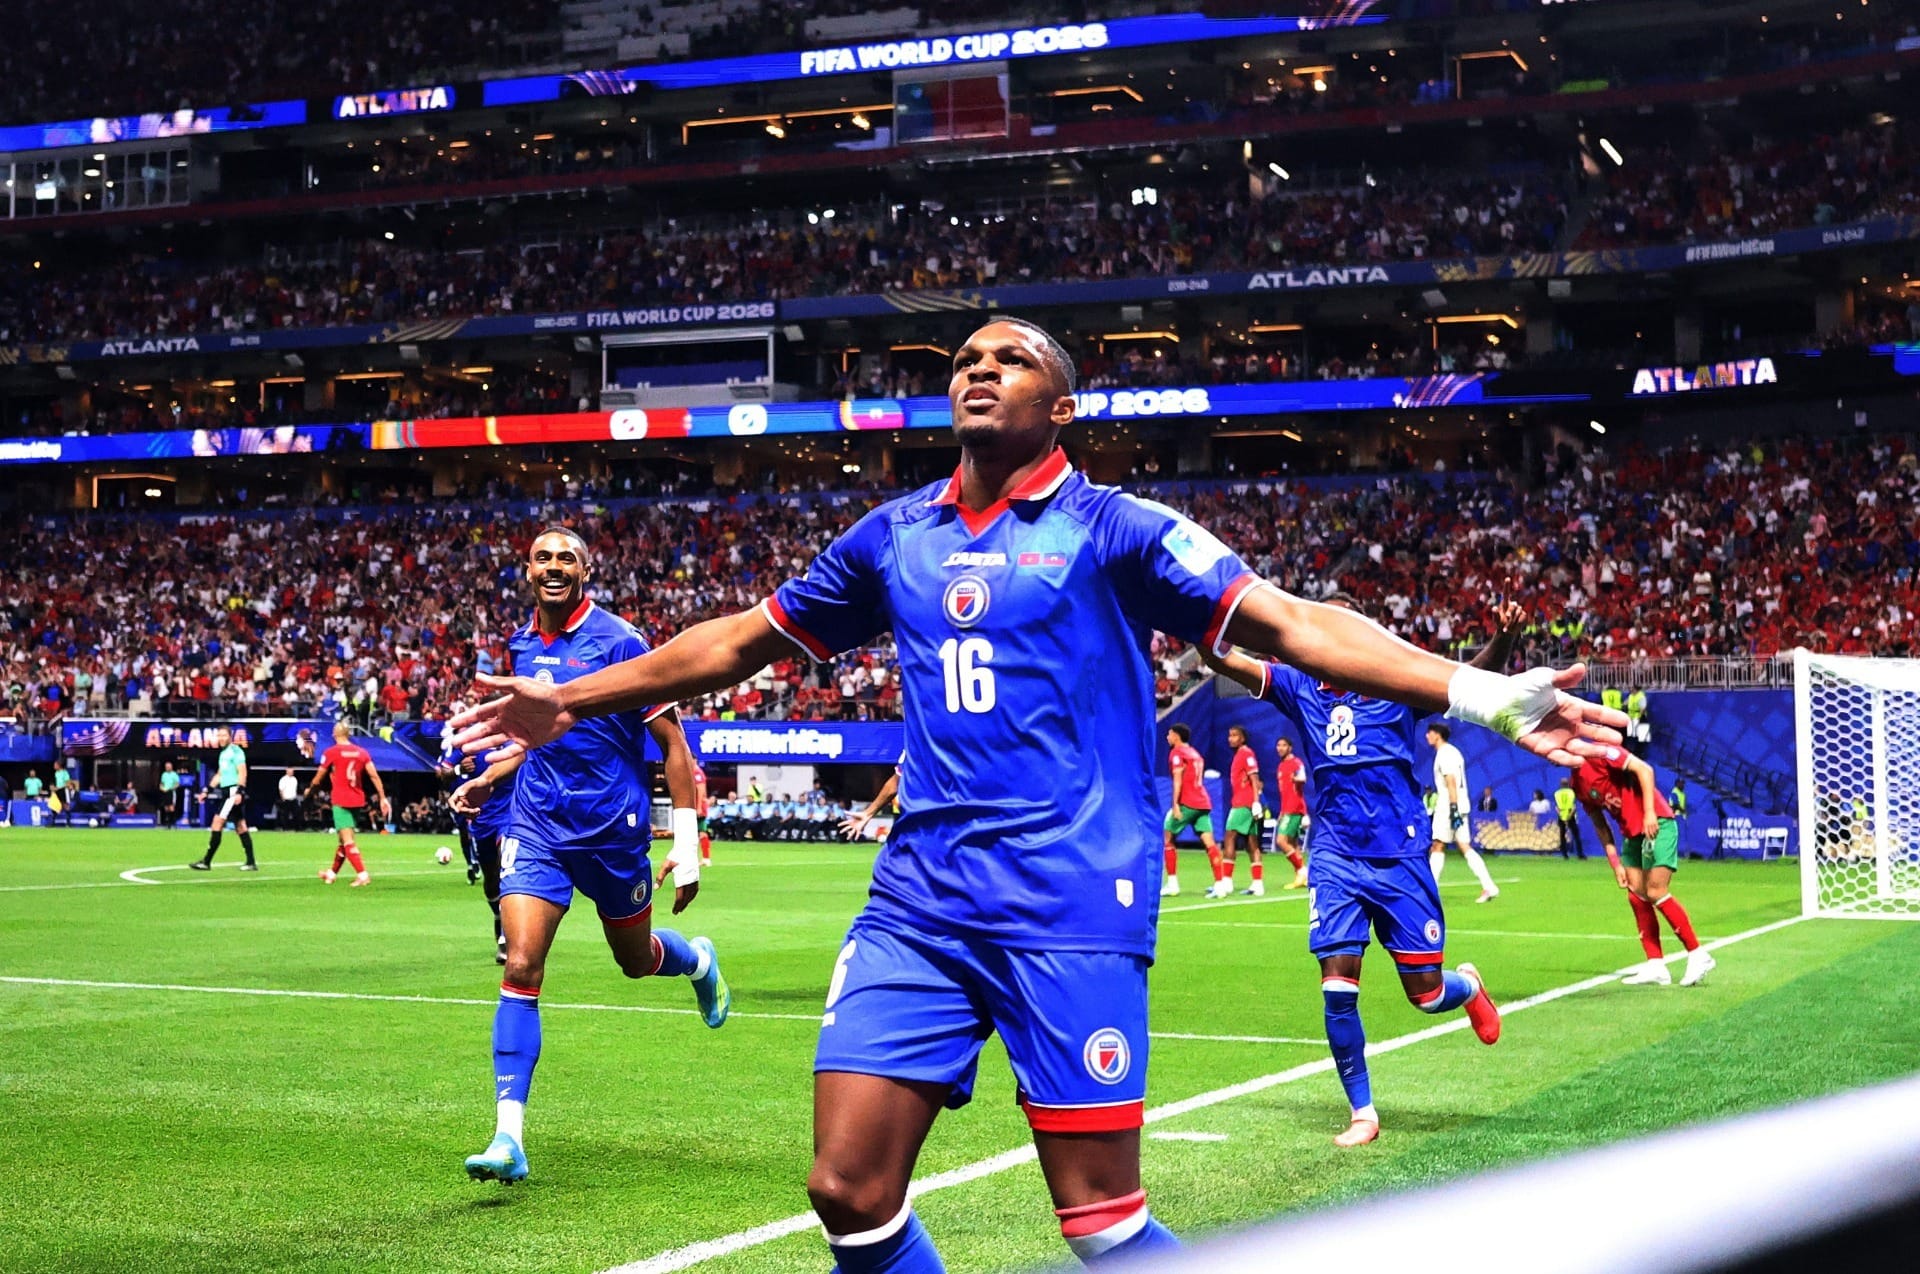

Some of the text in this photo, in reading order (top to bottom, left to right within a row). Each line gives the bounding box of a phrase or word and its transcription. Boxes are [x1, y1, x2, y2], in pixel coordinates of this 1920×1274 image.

[801, 23, 1108, 74] FIFA WORLD CUP 2026
[339, 86, 448, 118] ATLANTA
[1248, 266, 1389, 290] ATLANTA
[587, 312, 620, 327] FIFA
[622, 307, 681, 325] WORLD
[682, 306, 715, 322] CUP
[717, 302, 775, 320] 2026
[101, 338, 200, 356] ATLANTA
[1632, 357, 1778, 394] ATLANTA
[1073, 388, 1211, 417] UP 2026
[938, 637, 996, 714] 16
[145, 727, 248, 748] ATLANA
[700, 729, 843, 759] #FIFAWorldCup
[1325, 723, 1357, 756] 22
[346, 760, 357, 787] 4
[1727, 817, 1752, 829] FIFA
[1749, 828, 1765, 840] CU
